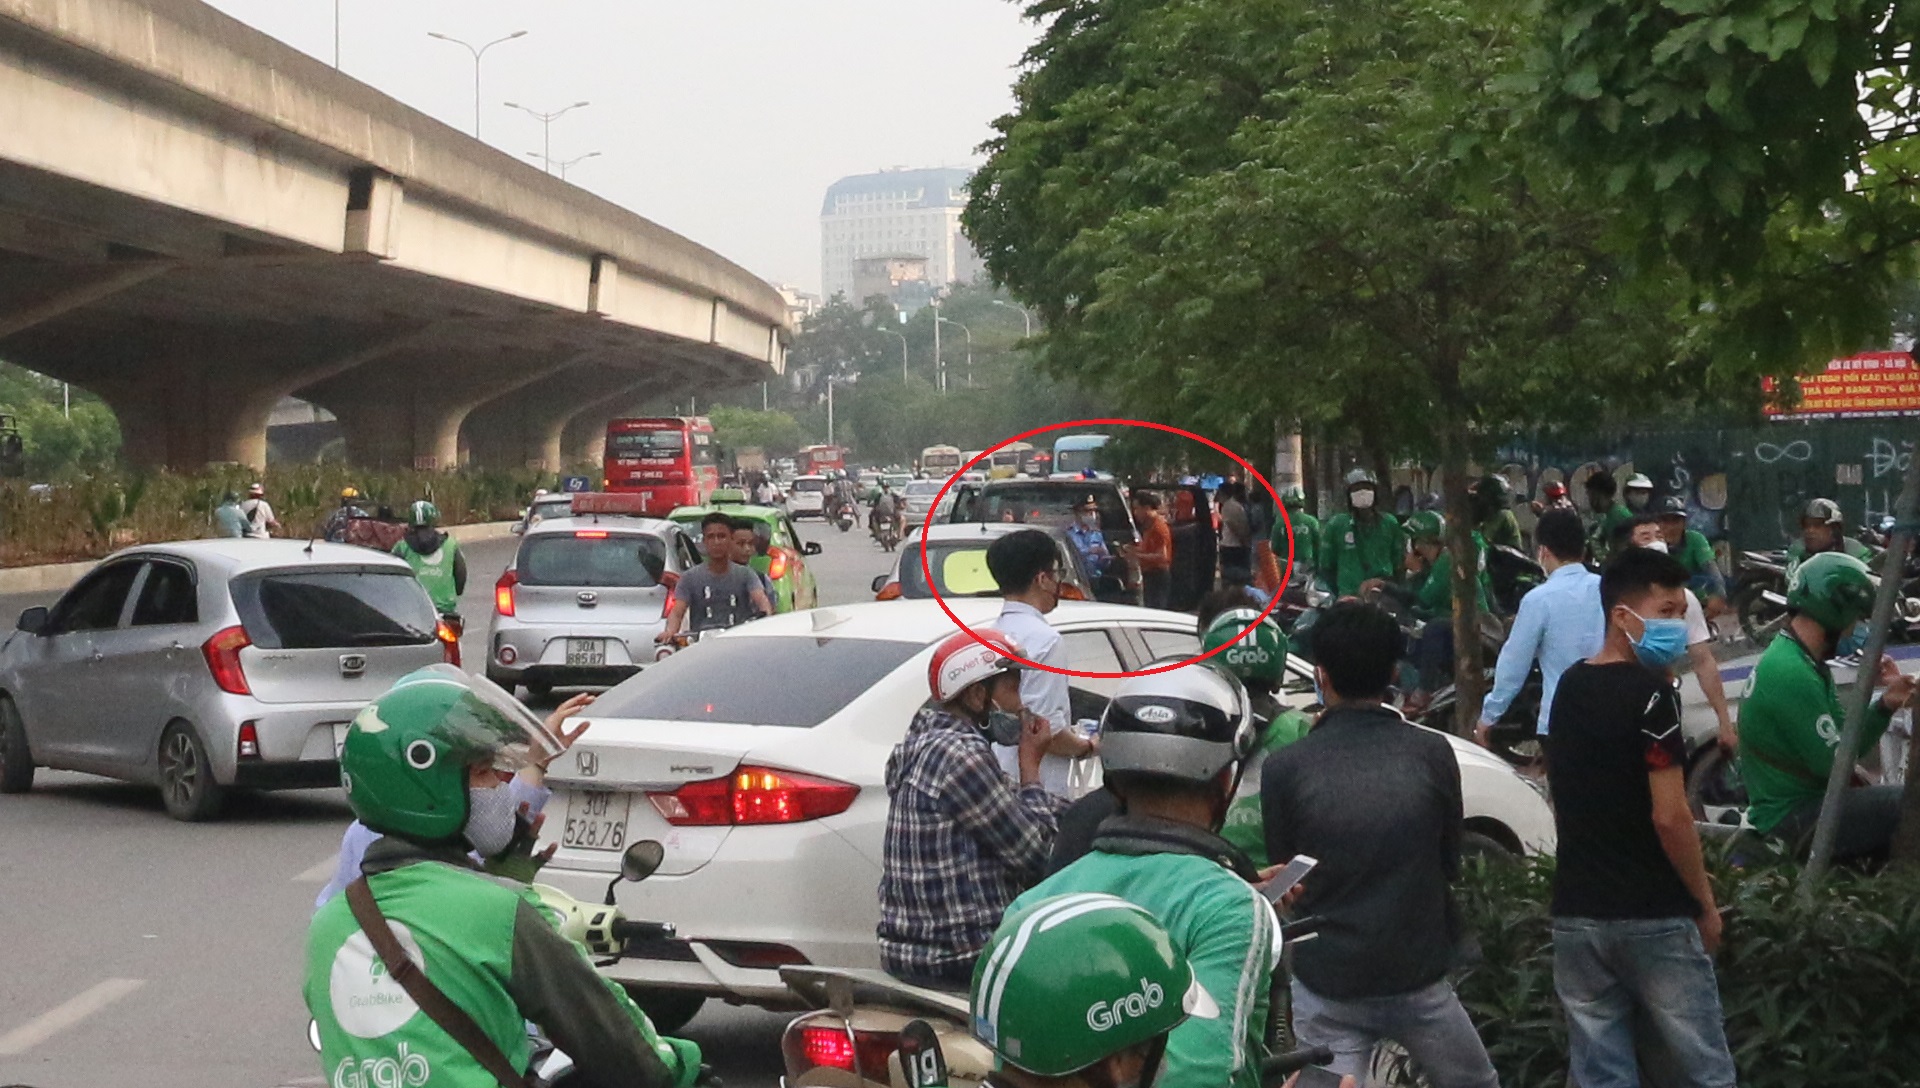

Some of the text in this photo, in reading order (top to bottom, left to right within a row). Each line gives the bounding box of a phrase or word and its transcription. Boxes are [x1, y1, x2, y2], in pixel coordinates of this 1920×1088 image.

[1226, 649, 1269, 665] Grab
[565, 818, 624, 847] 528.76
[1086, 976, 1164, 1032] Grab
[334, 1041, 430, 1088] Grab
